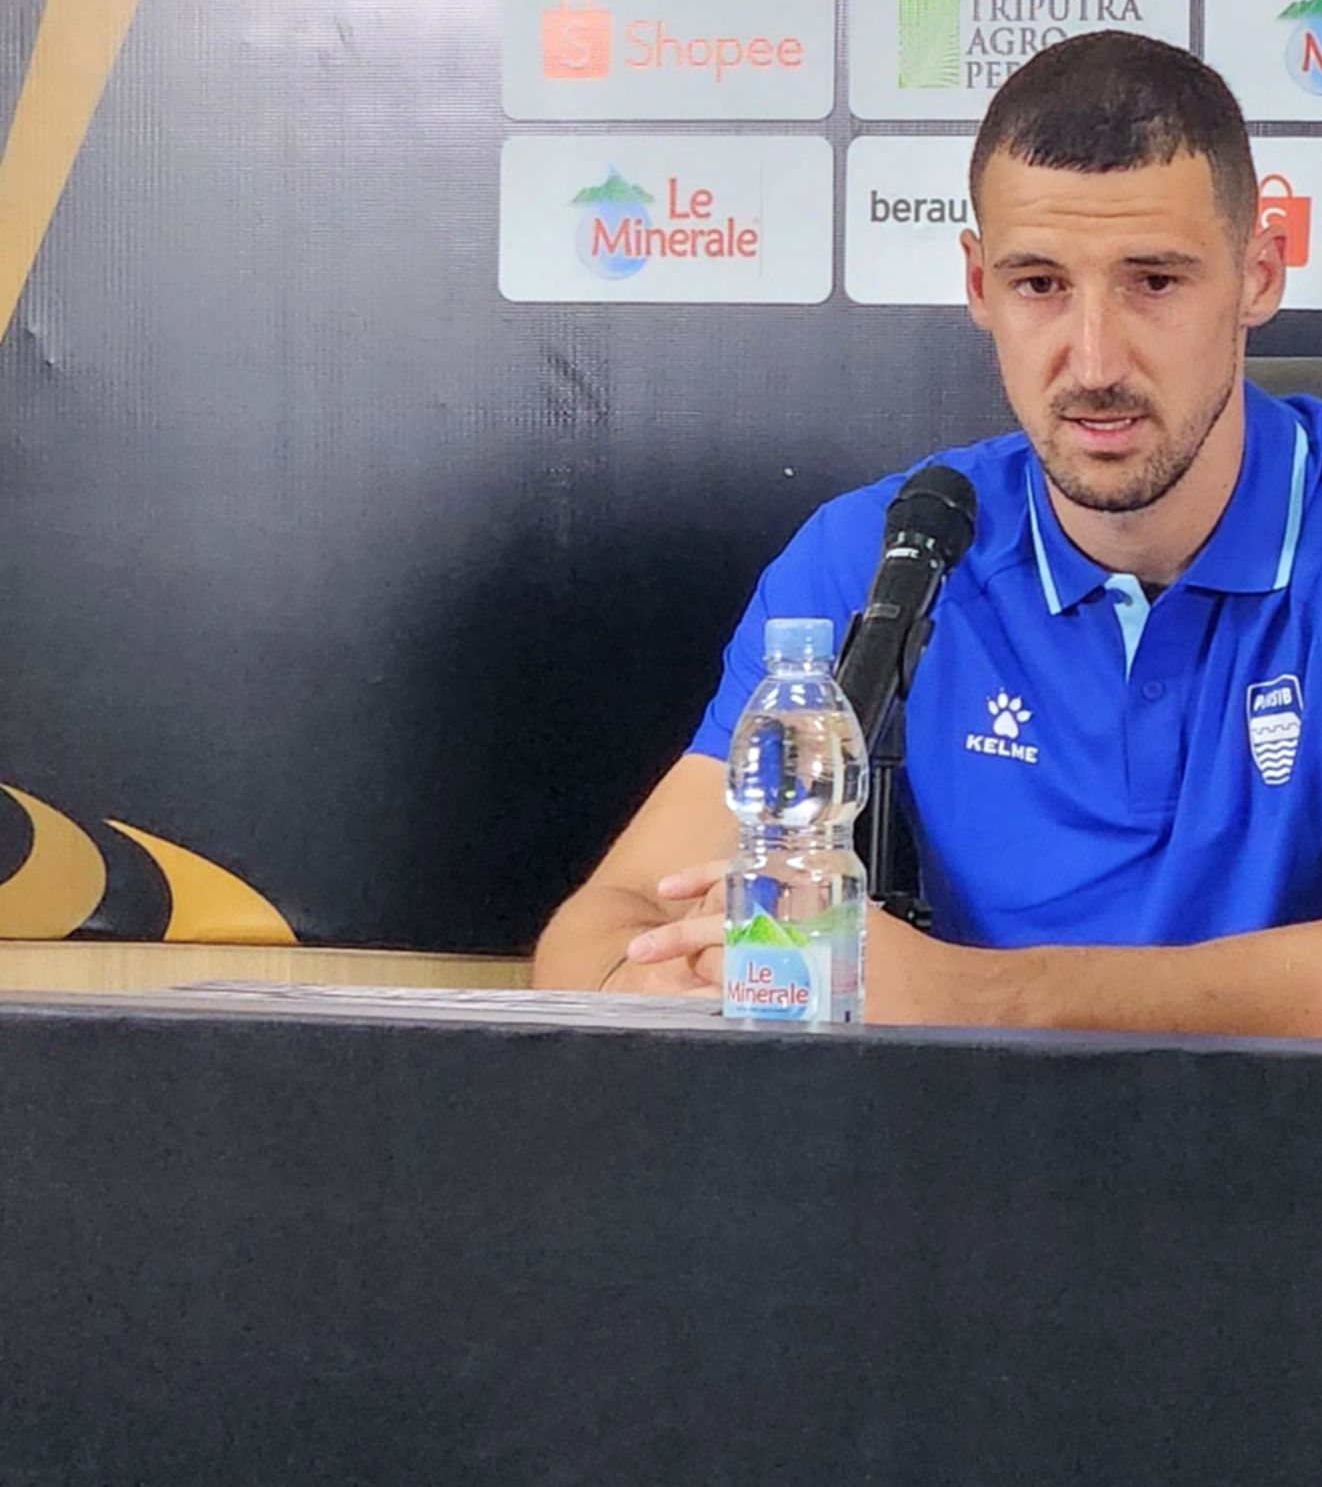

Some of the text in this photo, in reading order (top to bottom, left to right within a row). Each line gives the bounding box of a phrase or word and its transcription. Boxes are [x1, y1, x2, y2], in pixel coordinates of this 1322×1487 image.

[625, 19, 804, 81] Shopee
[668, 177, 713, 219] Le
[869, 189, 968, 223] berau
[591, 215, 758, 257] Minerale
[966, 733, 1039, 763] KELME
[749, 960, 772, 984] Le
[728, 980, 809, 1004] Minerale
